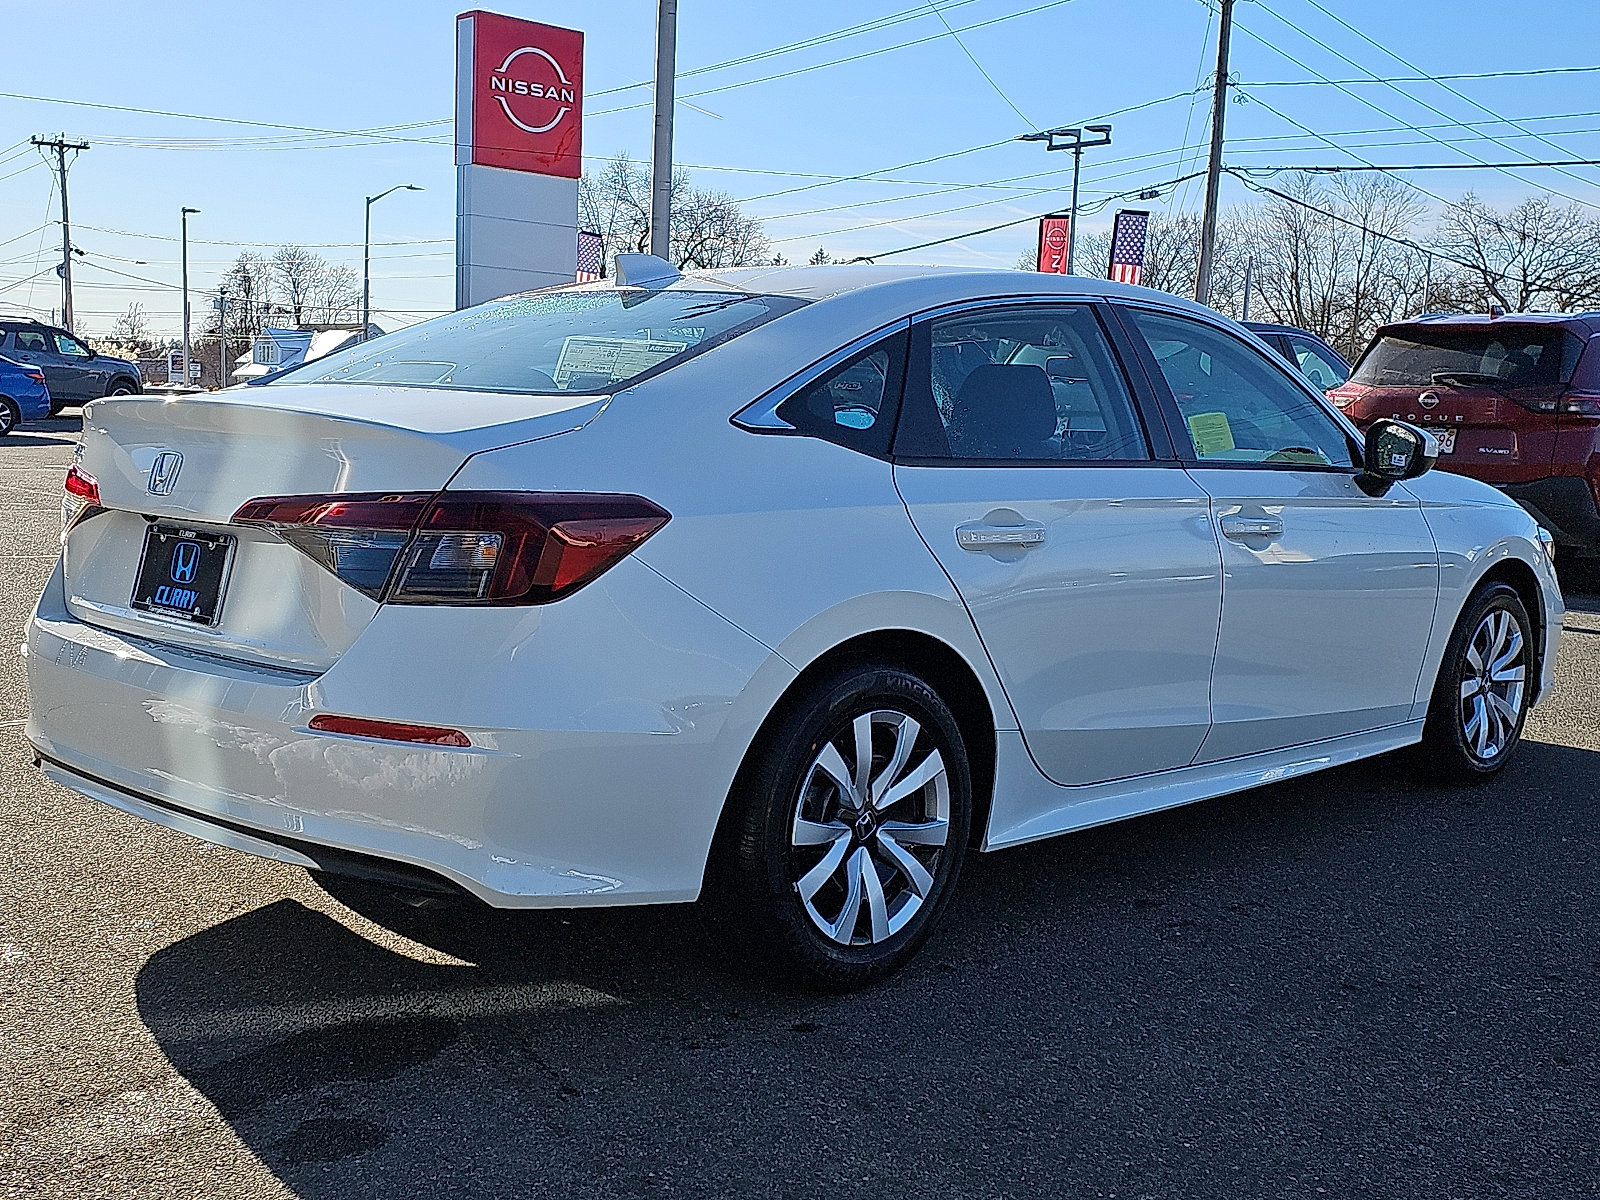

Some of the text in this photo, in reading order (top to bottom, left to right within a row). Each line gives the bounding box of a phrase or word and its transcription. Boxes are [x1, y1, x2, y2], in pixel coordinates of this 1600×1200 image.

[491, 75, 574, 103] NISSAN
[1434, 433, 1453, 448] 96
[154, 585, 200, 610] CURRY
